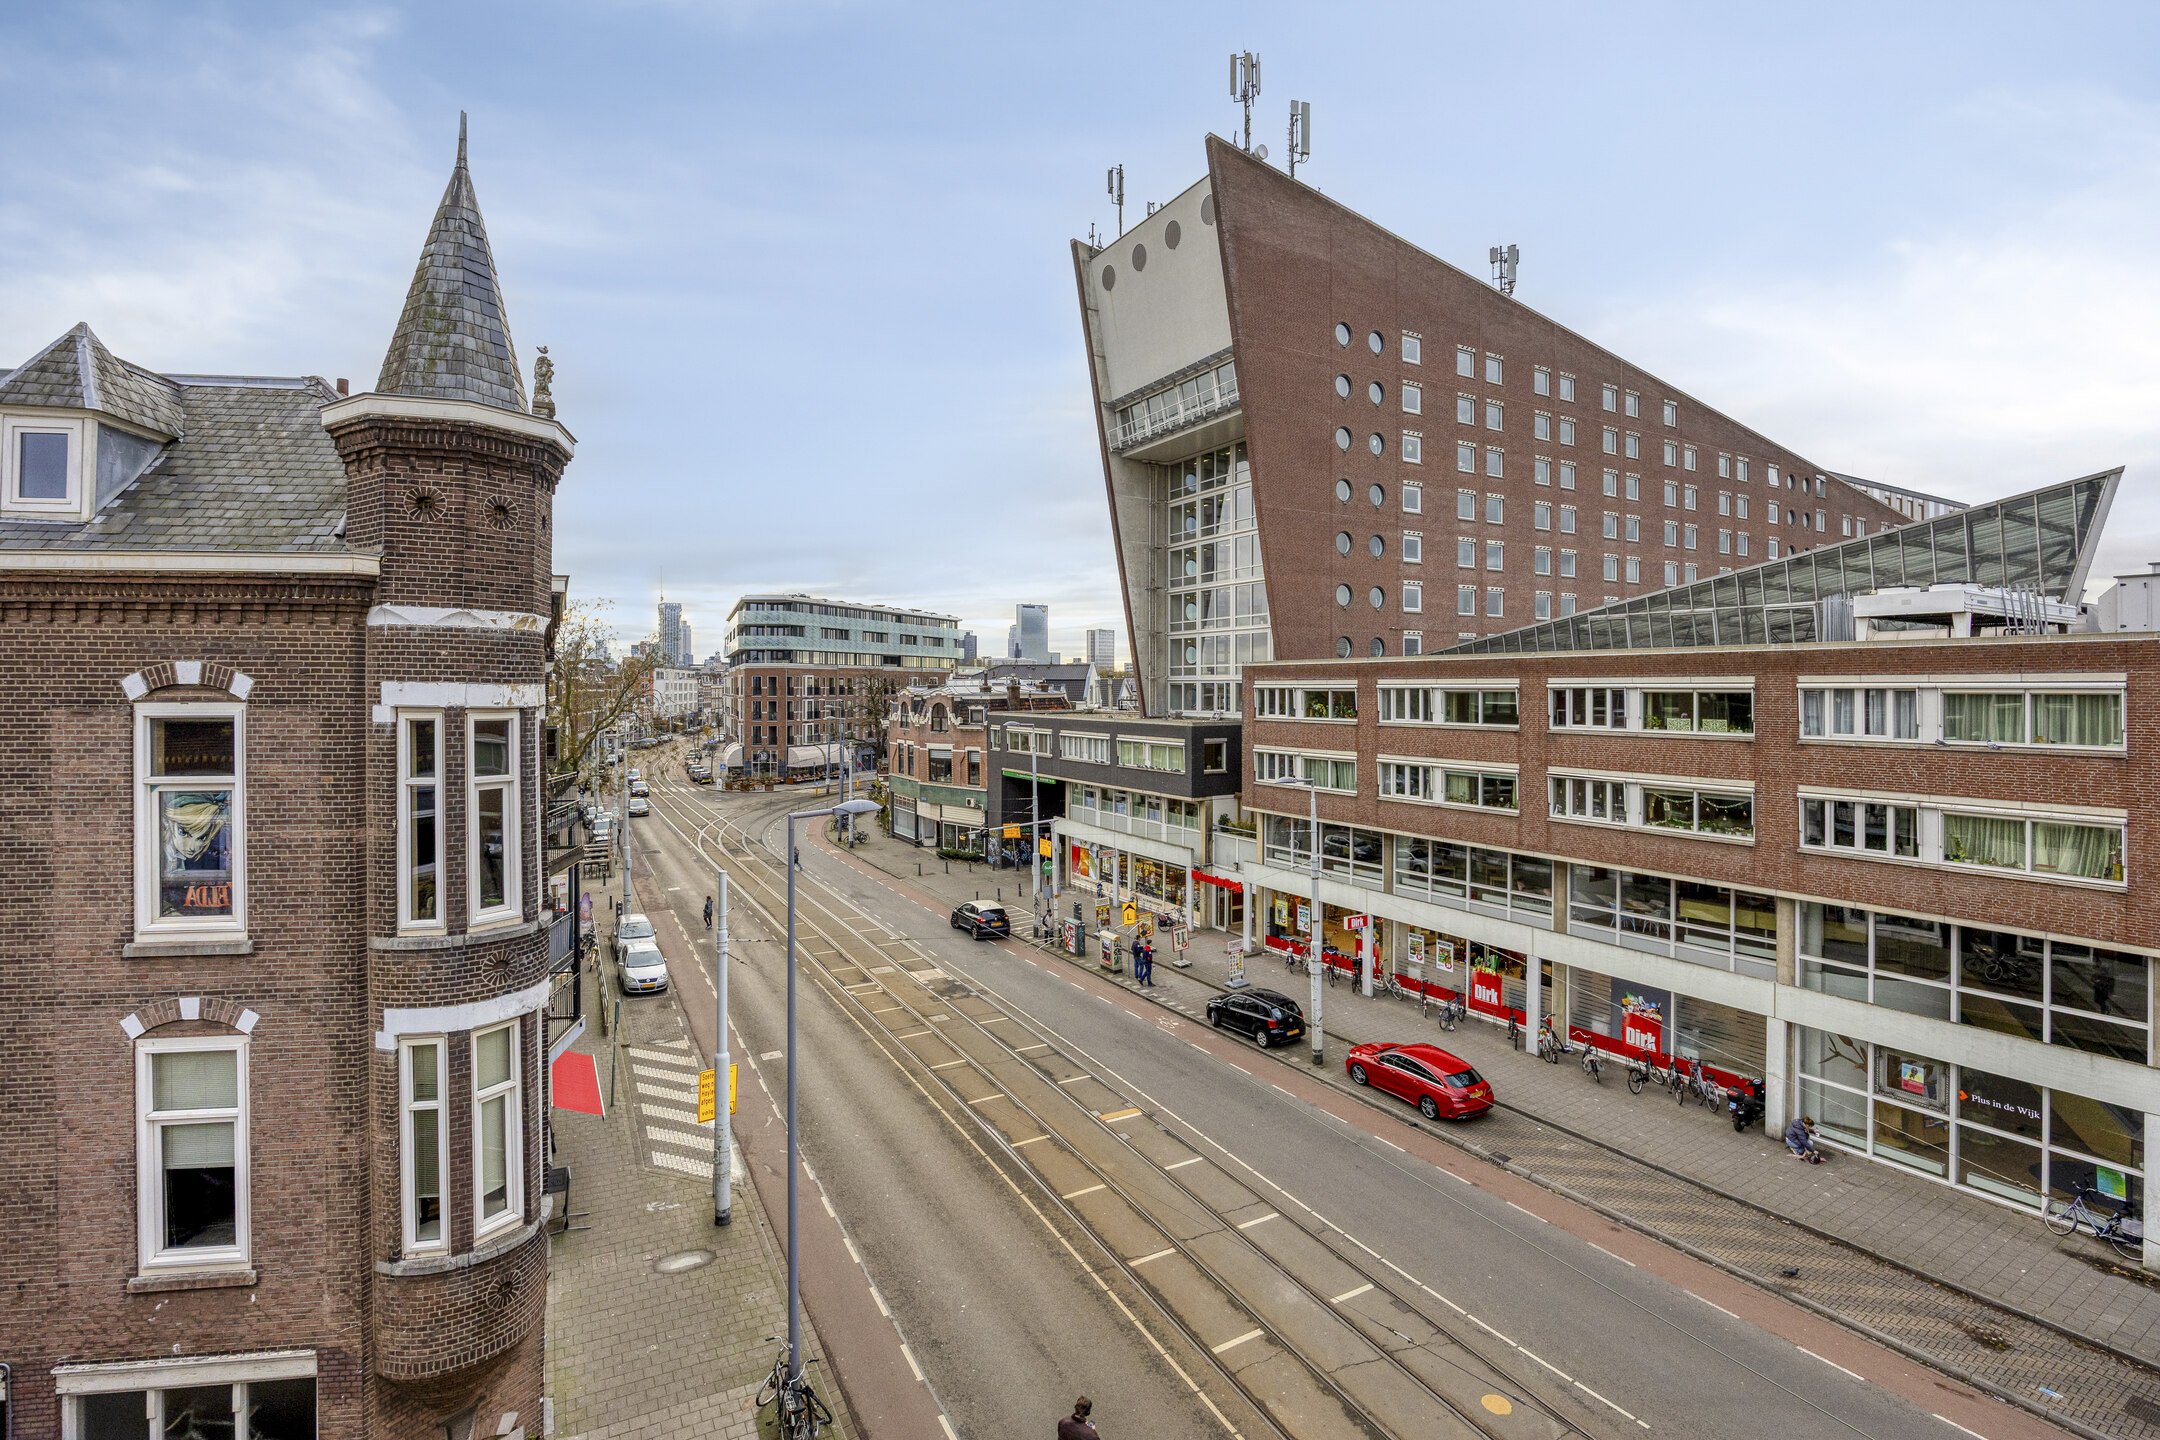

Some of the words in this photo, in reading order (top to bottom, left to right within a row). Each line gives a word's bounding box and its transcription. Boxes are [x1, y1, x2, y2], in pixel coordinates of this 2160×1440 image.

[1127, 912, 1132, 921] L
[1351, 916, 1364, 928] Dirk
[1474, 983, 1499, 1006] Dirk
[1625, 1026, 1657, 1053] Dirk
[1971, 1094, 1991, 1106] Plus
[1992, 1099, 2002, 1109] in
[2003, 1103, 2015, 1112] de
[2017, 1106, 2041, 1119] Wijk
